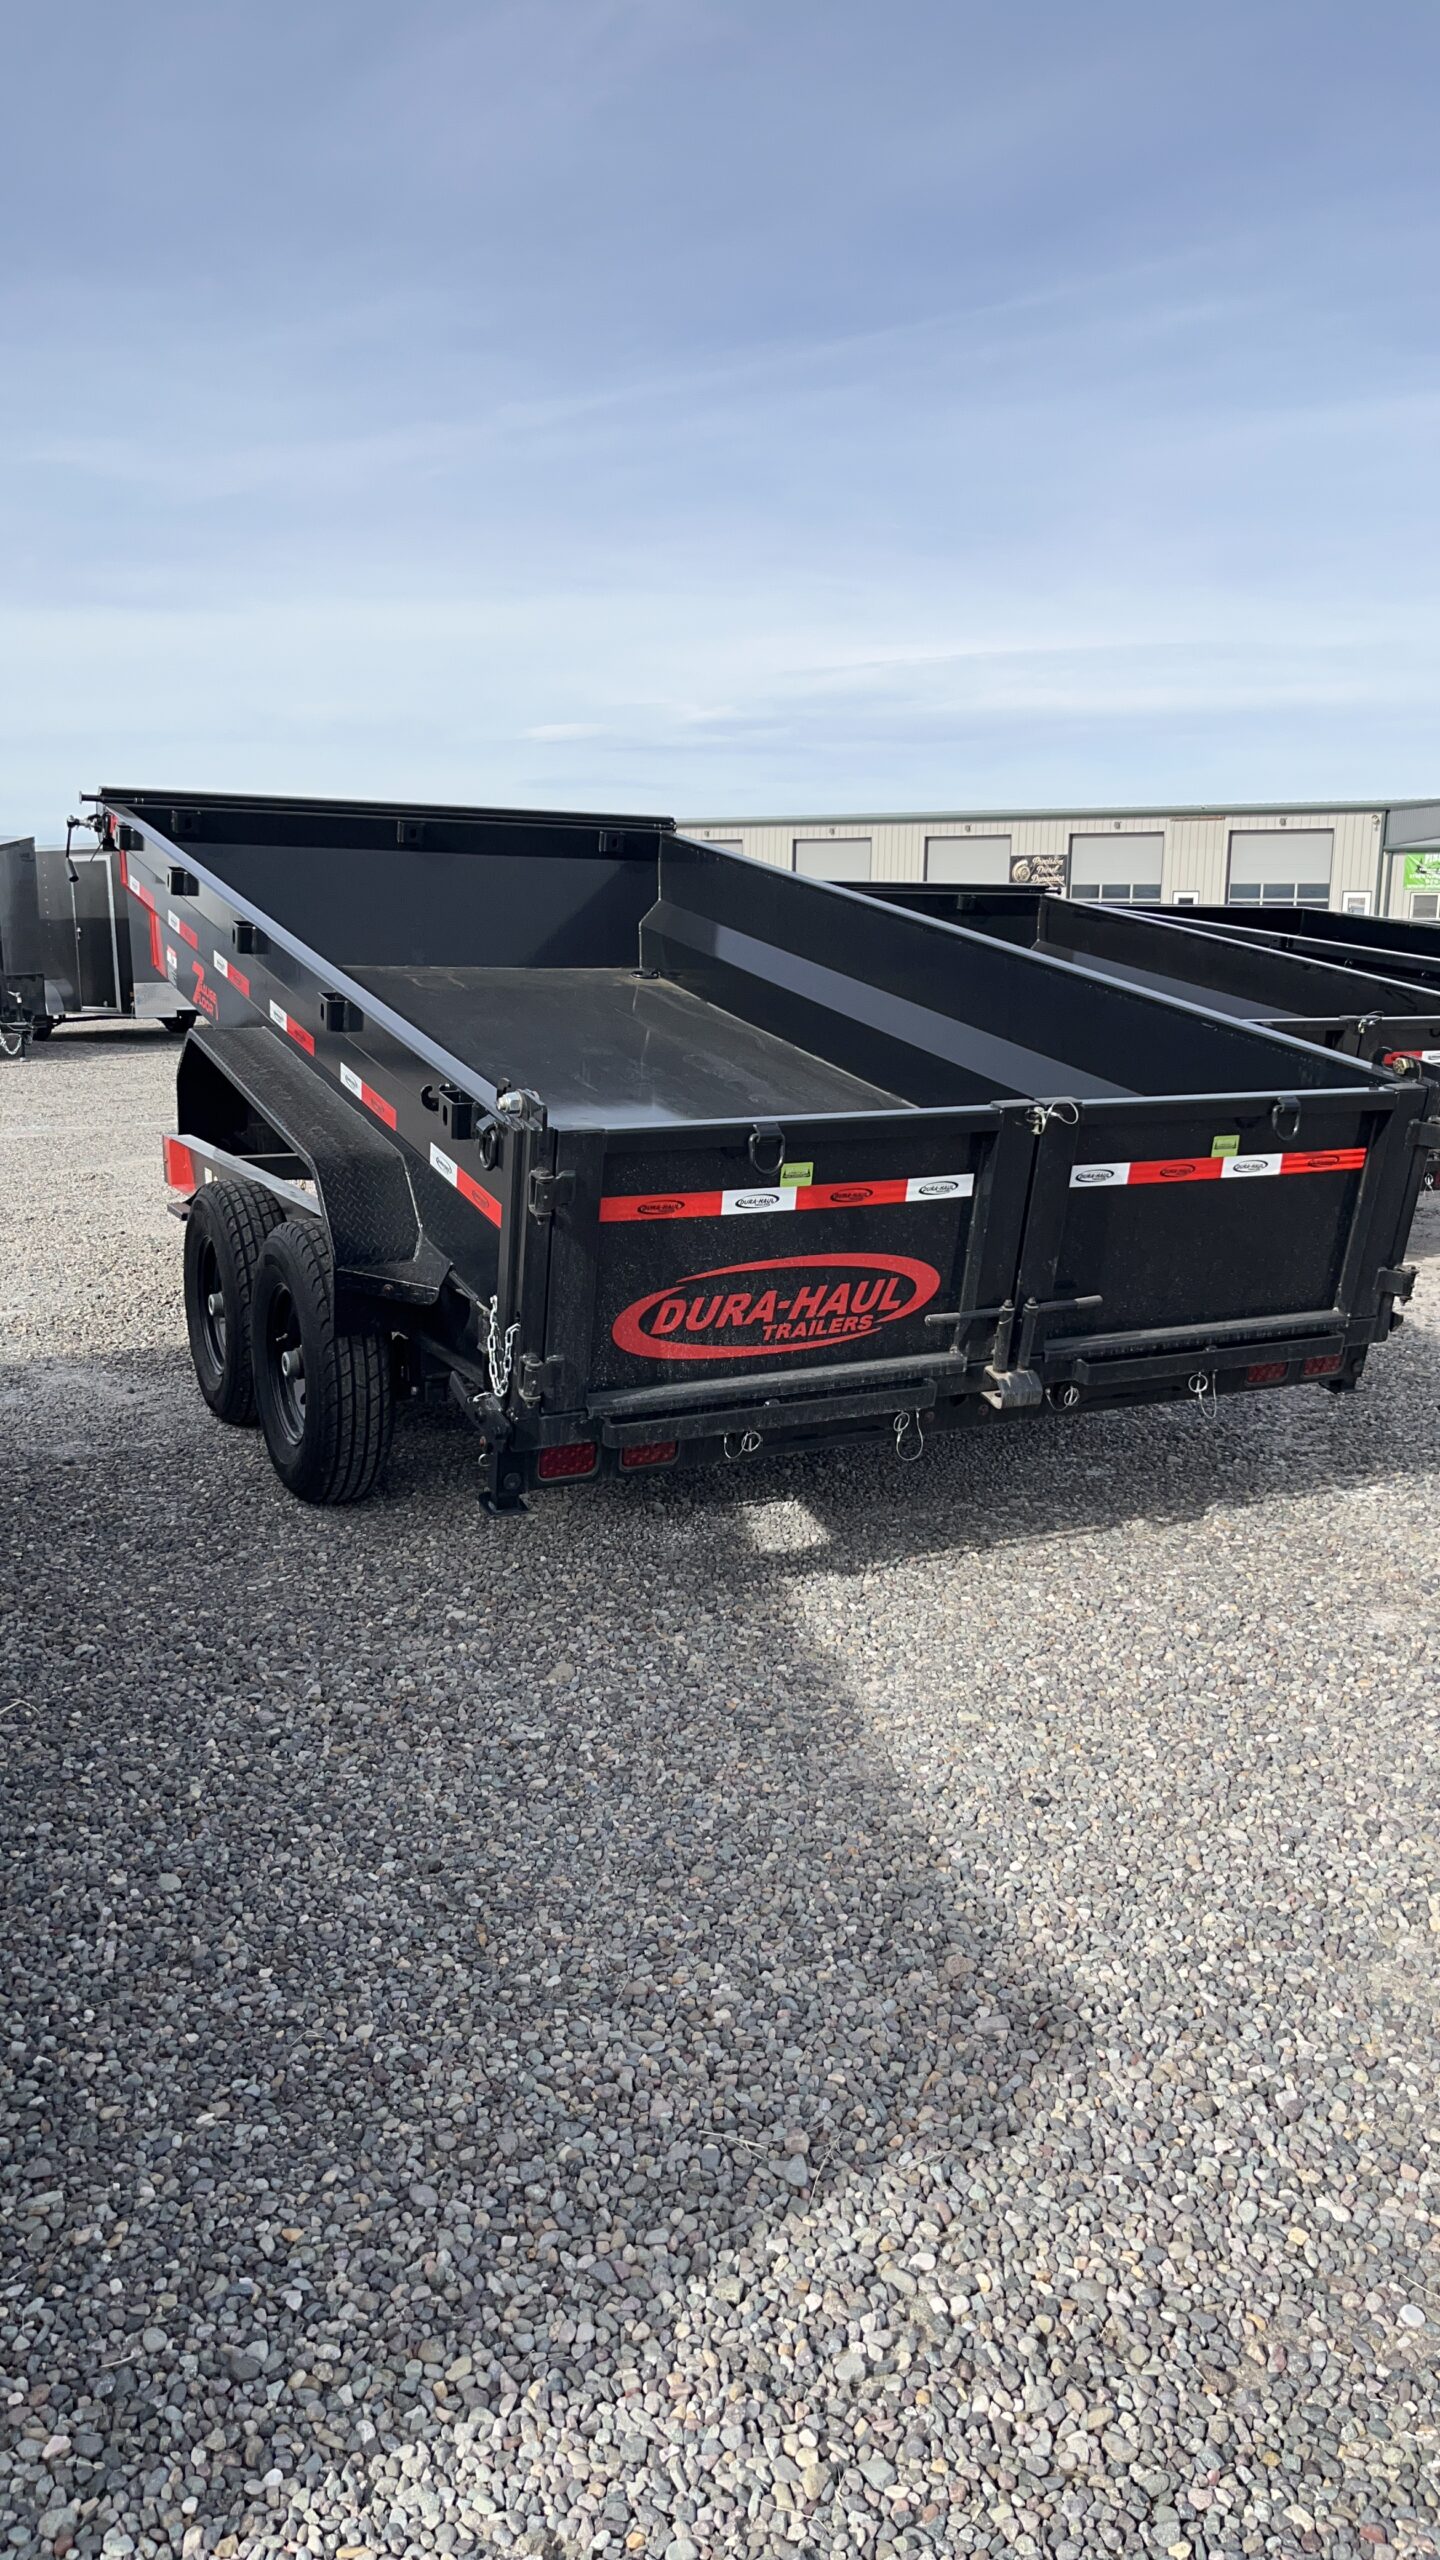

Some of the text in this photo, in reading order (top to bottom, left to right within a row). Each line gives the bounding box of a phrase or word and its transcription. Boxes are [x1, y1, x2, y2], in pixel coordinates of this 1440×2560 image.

[740, 1198, 775, 1206] DURA-HAUL
[650, 1277, 902, 1335] DURA-HAUL
[763, 1314, 873, 1341] TRAILERS
